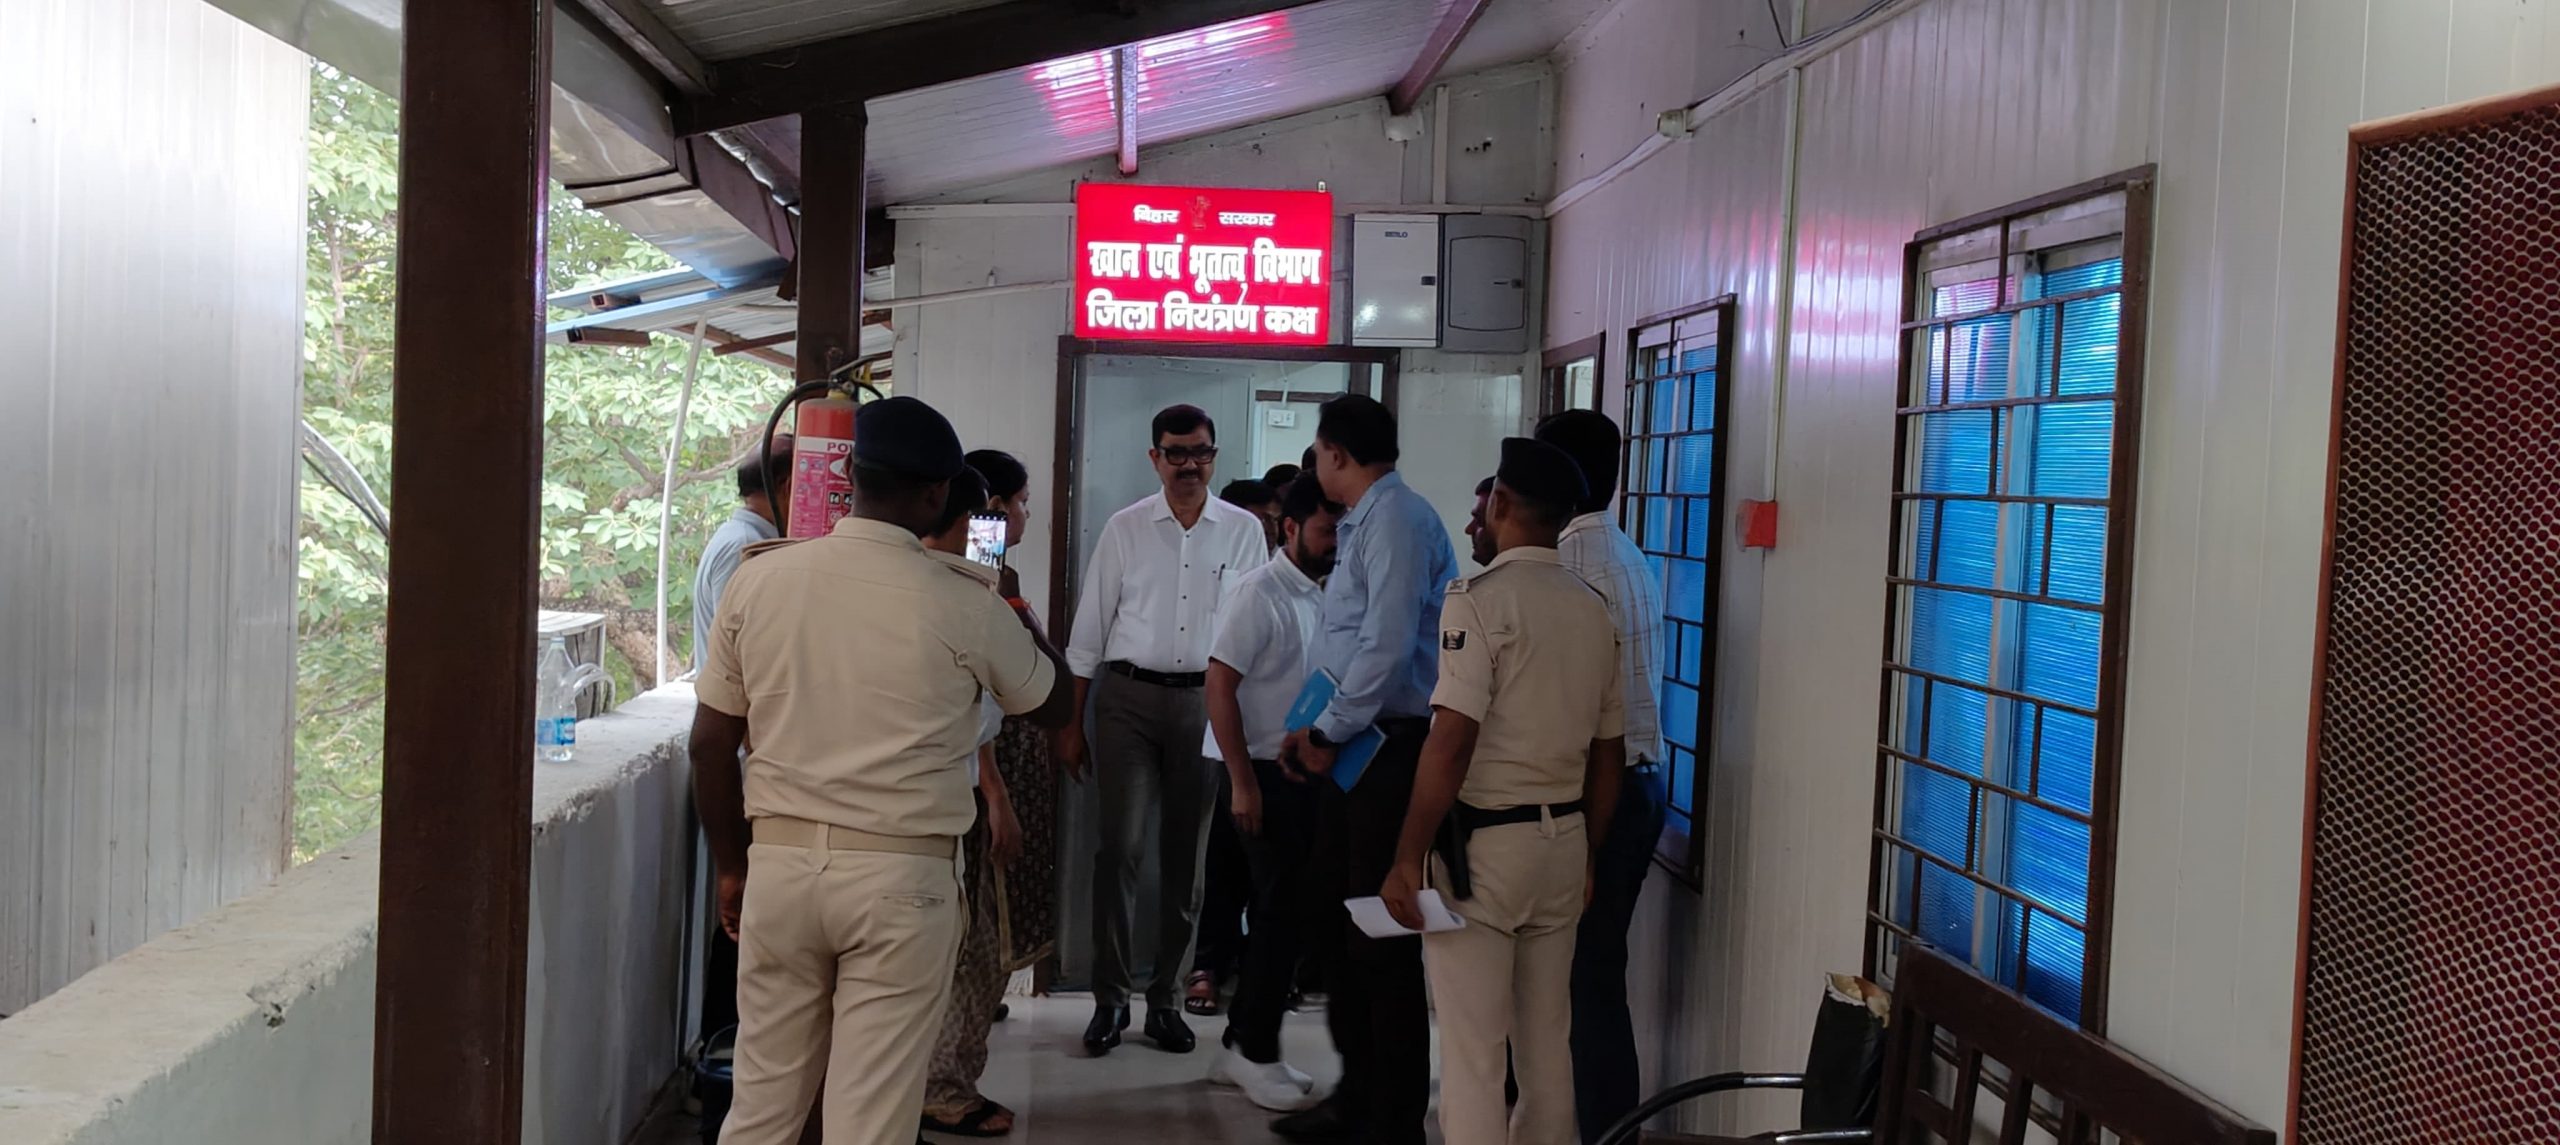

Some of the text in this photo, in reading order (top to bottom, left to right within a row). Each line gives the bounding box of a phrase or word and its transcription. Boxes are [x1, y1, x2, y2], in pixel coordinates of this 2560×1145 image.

[1133, 204, 1276, 226] बिहार सरकार
[1088, 241, 1142, 278] खान
[1146, 233, 1184, 280] एवं
[1253, 237, 1322, 285] विभाग
[1086, 287, 1159, 330] जिला
[1264, 305, 1319, 335] कक्ष
[827, 442, 853, 453] PO
